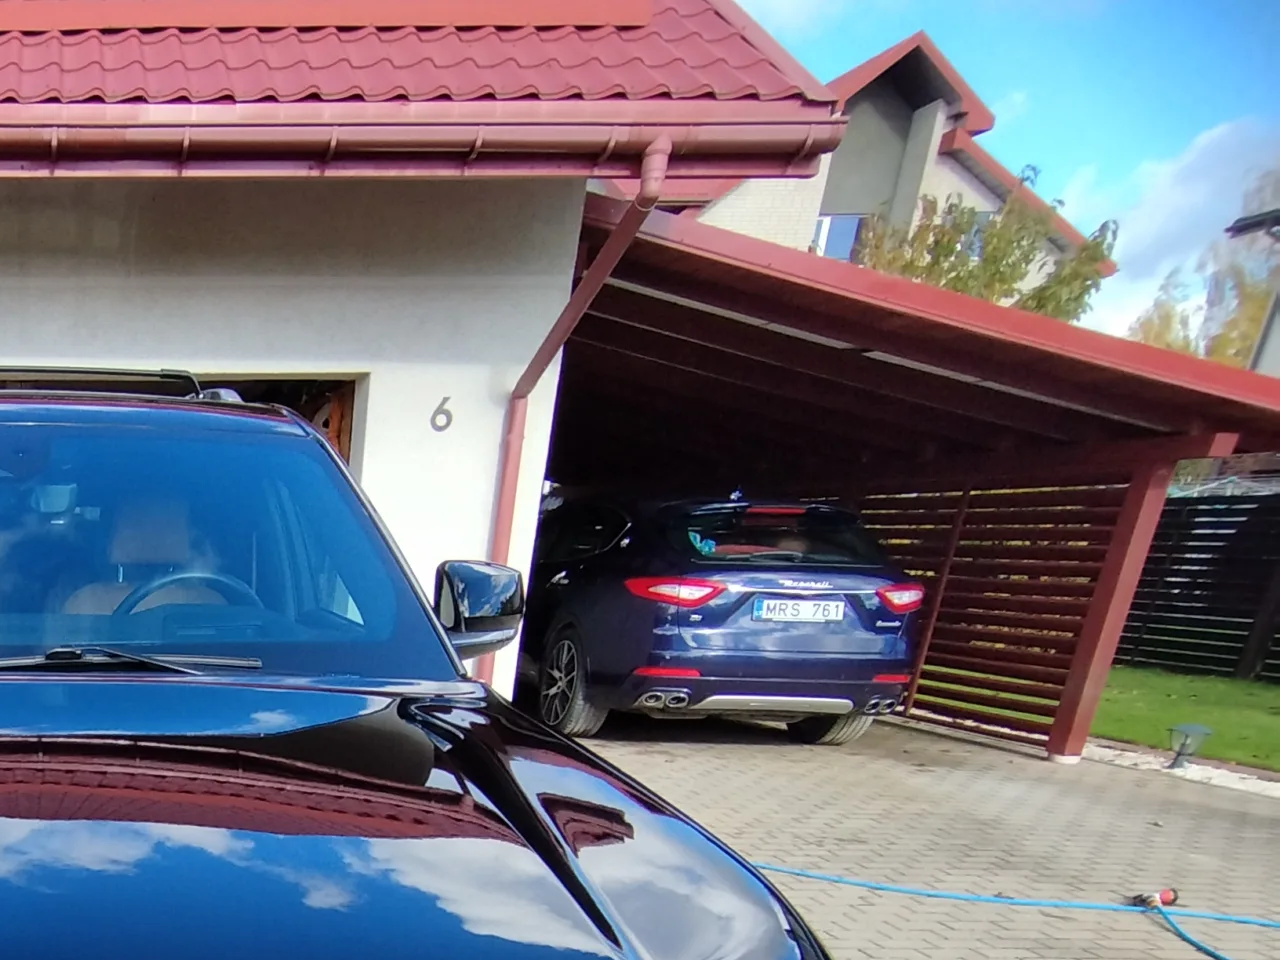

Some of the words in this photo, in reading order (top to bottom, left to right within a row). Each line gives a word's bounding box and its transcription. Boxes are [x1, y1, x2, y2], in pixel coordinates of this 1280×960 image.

[430, 396, 453, 432] 6
[765, 602, 801, 617] MRS
[812, 603, 840, 618] 761
